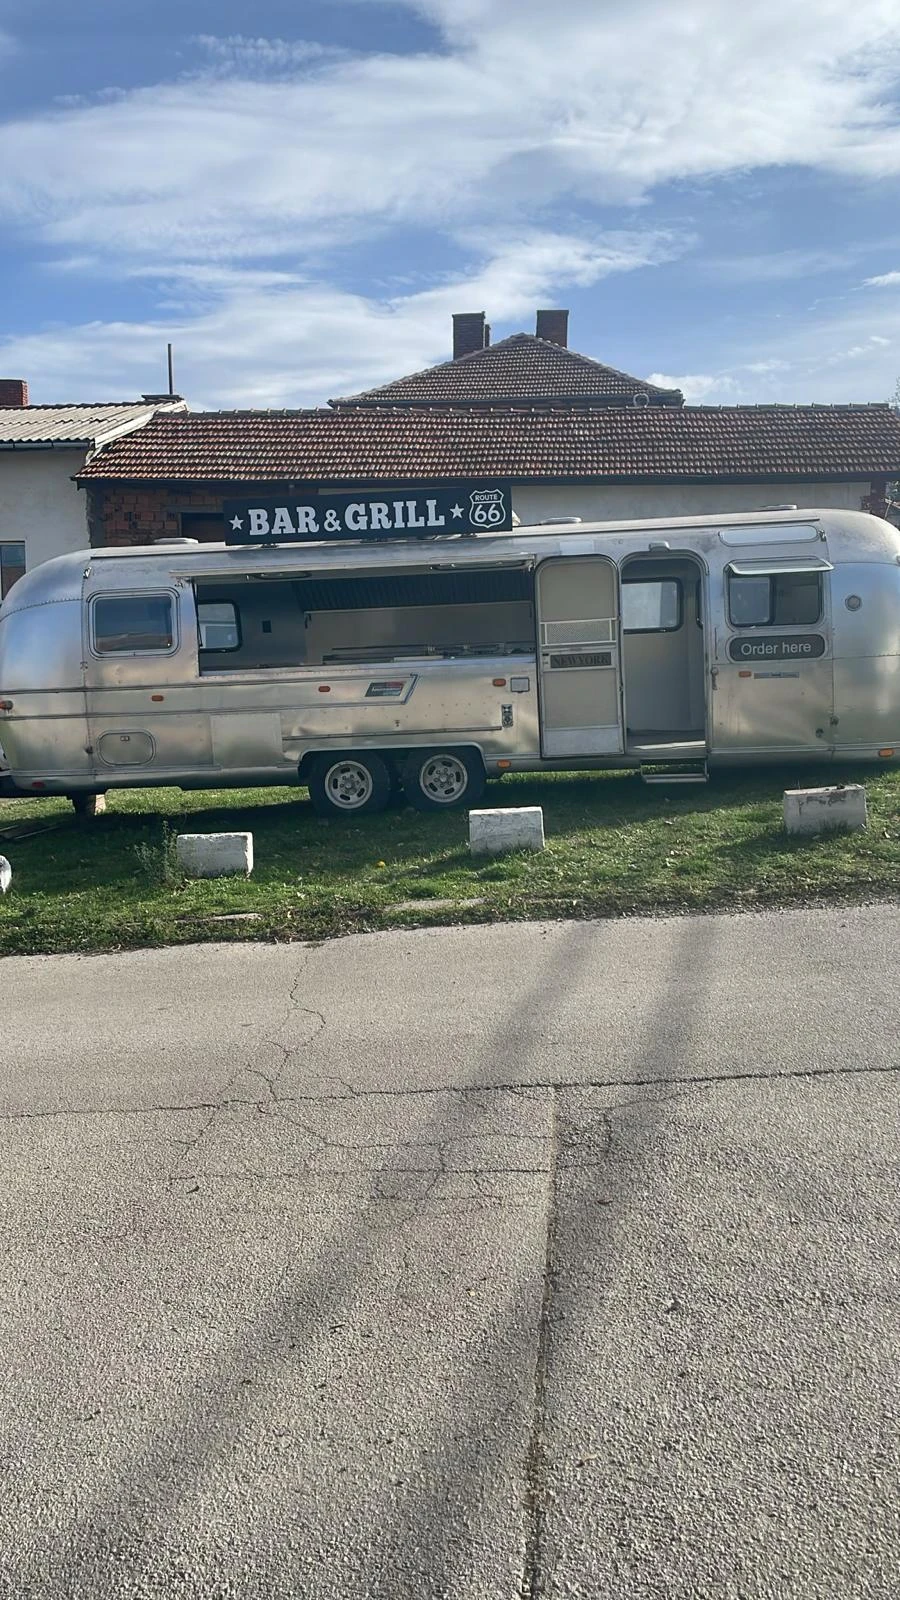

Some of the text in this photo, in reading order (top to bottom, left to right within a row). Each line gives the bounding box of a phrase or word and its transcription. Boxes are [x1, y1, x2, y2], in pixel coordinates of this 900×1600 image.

[248, 499, 445, 535] BAR & GRILL
[474, 503, 500, 523] 66
[741, 642, 811, 655] Order here
